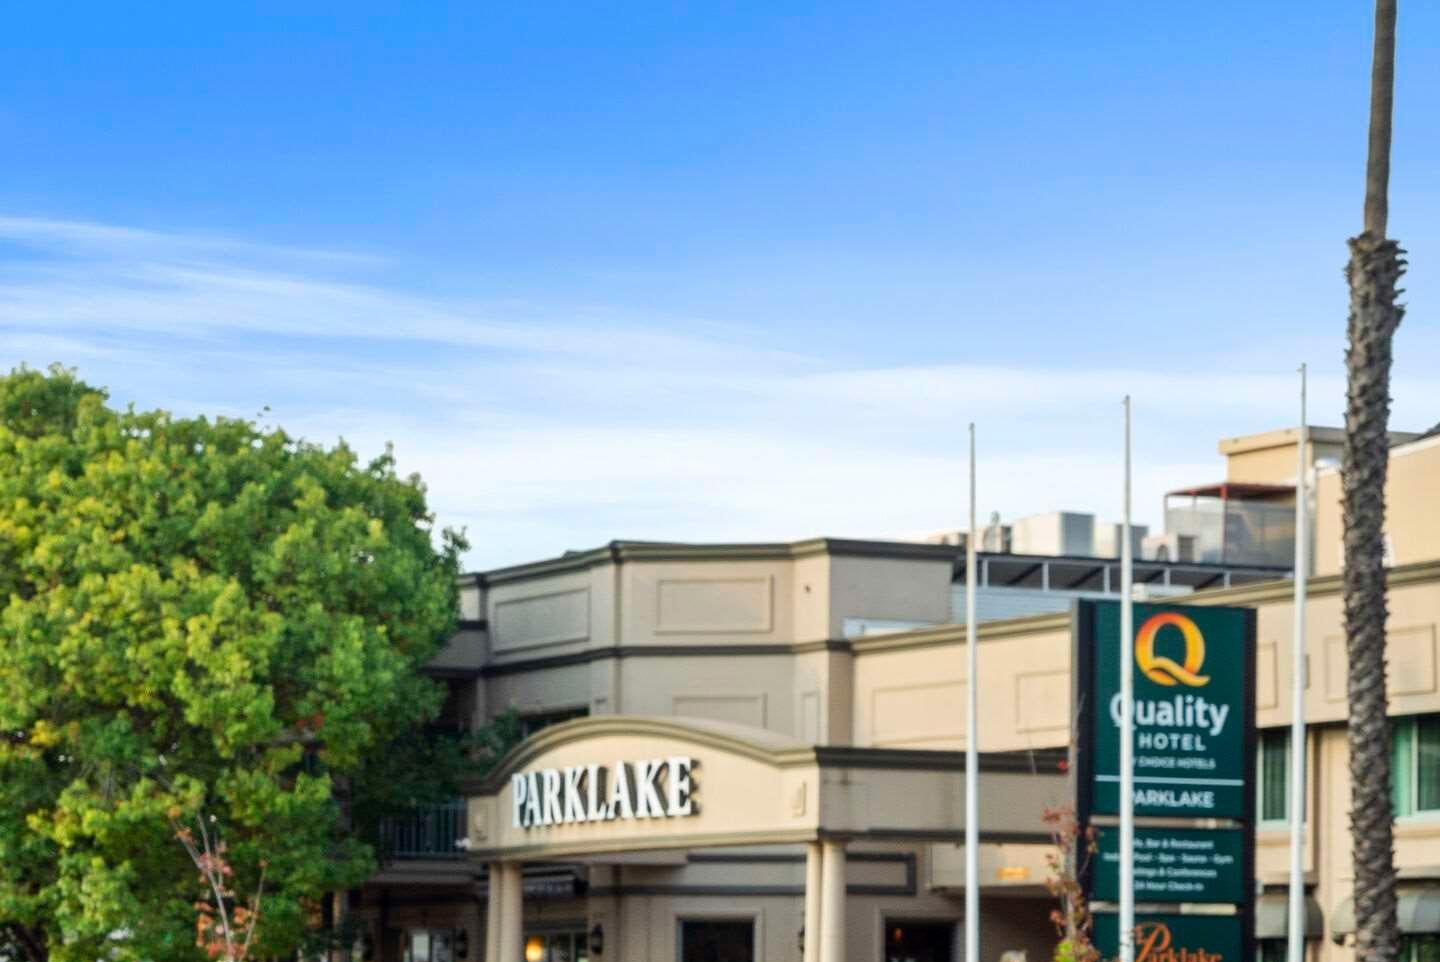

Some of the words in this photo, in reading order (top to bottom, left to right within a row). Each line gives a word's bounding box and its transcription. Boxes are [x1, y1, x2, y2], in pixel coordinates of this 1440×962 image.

[1135, 612, 1210, 687] Q
[1109, 692, 1229, 736] Quality
[1138, 733, 1206, 751] HOTEL
[511, 757, 694, 828] PARKLAKE
[1131, 789, 1215, 808] ARKLAKE
